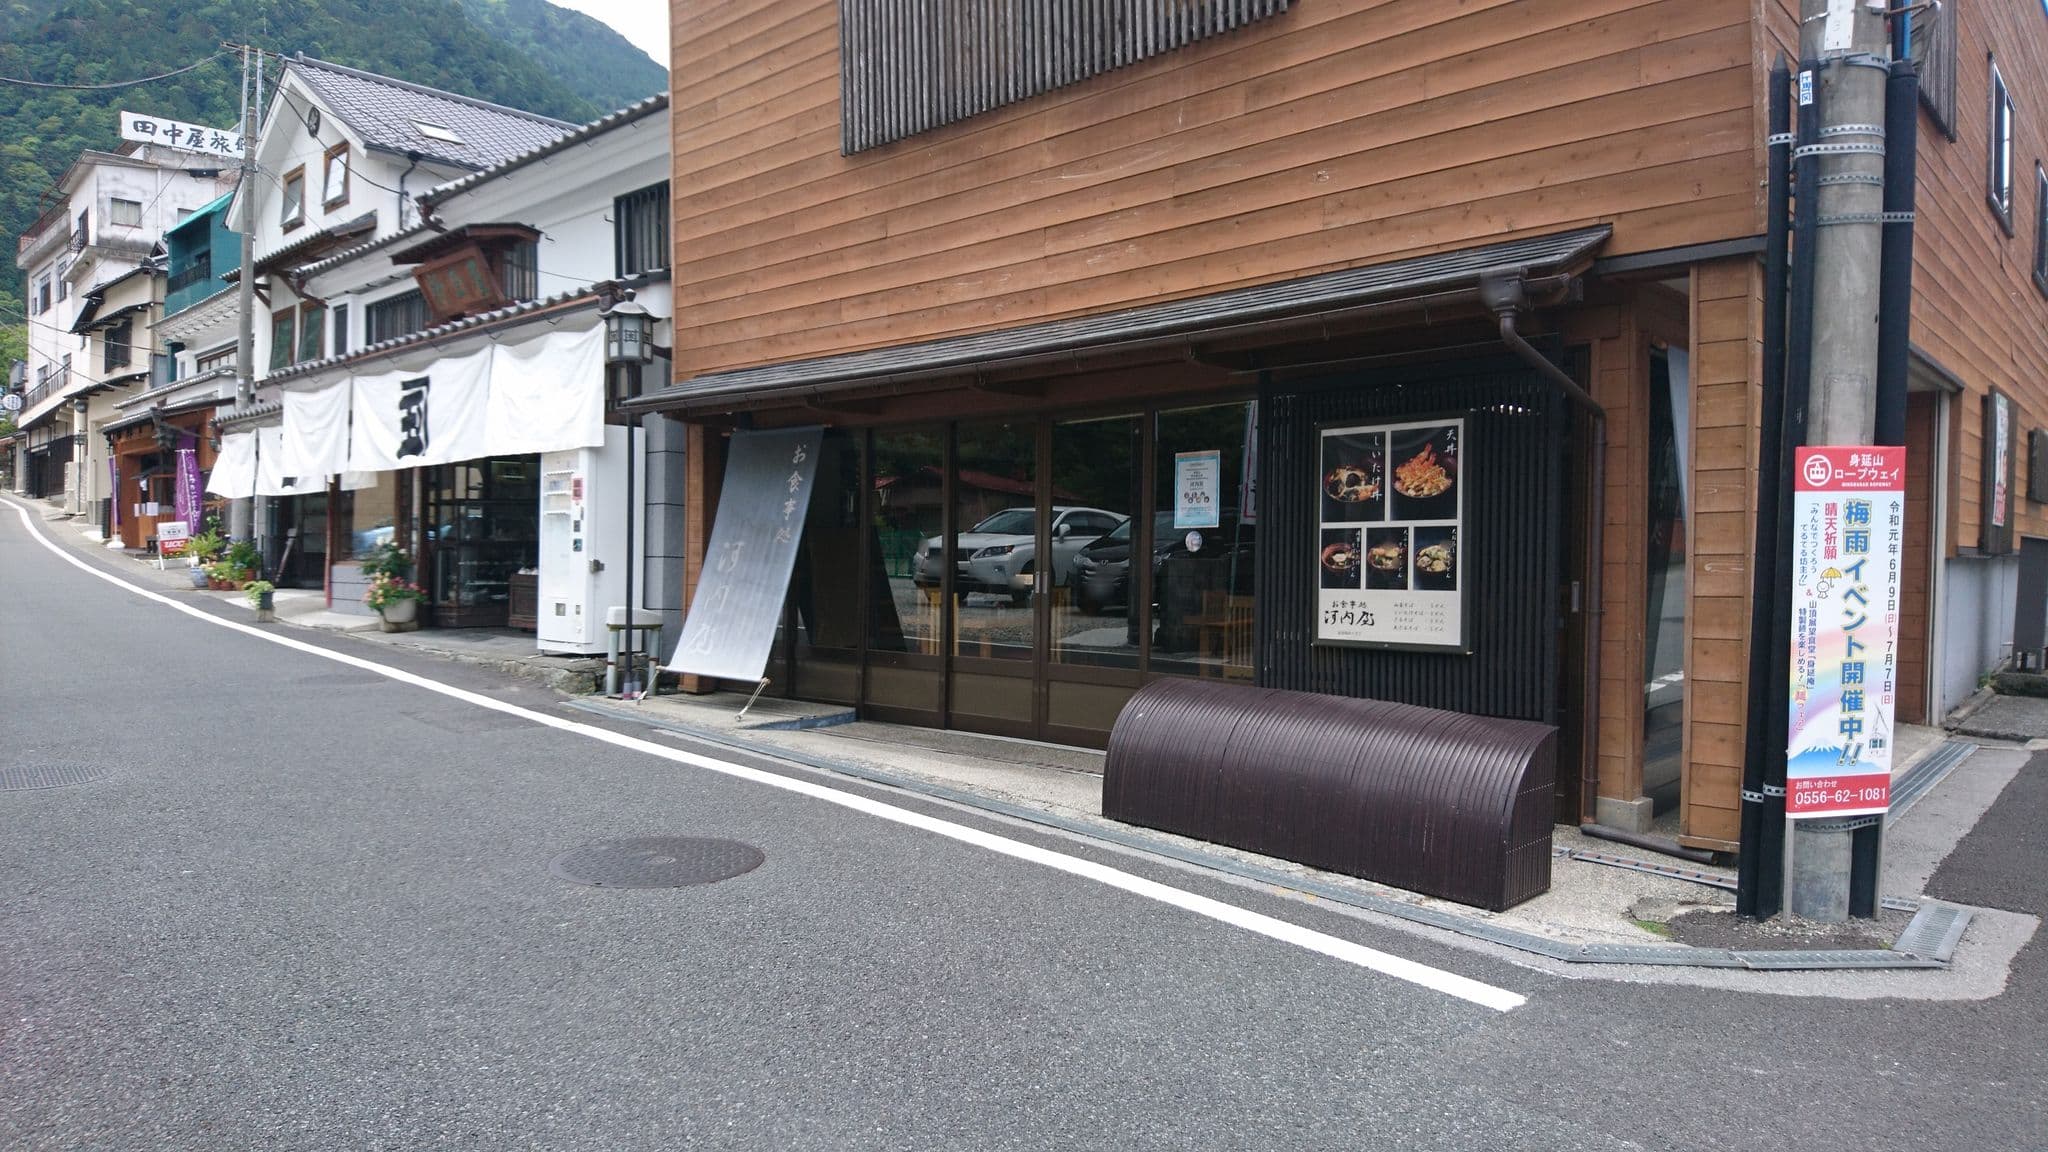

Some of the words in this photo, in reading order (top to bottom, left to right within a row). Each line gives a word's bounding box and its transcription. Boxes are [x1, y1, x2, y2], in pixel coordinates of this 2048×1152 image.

[1849, 453, 1884, 467] 身延山
[1834, 467, 1900, 481] ロープウェイ
[775, 444, 807, 544] お食事処
[1823, 502, 1838, 561] 晴天祈願
[1795, 780, 1838, 790] お問い合わせ
[1794, 787, 1887, 805] 0556-62-1081
